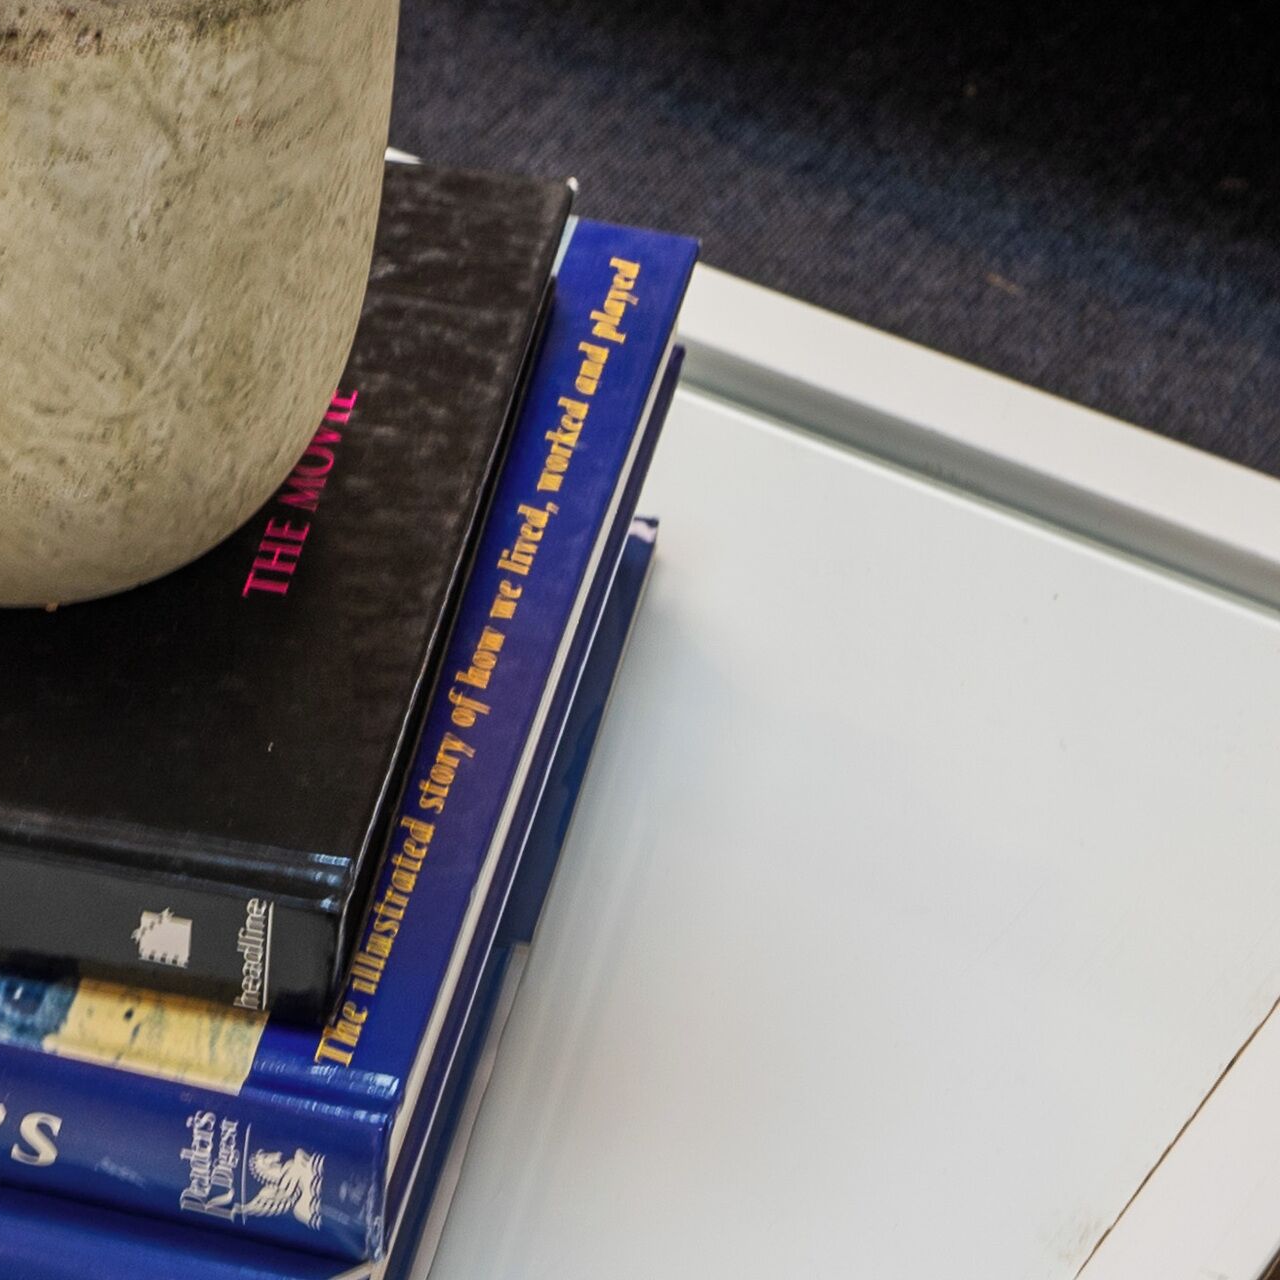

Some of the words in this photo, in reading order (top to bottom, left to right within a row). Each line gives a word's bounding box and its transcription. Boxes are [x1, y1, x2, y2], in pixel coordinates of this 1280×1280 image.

[590, 257, 640, 344] played
[575, 342, 609, 395] and
[537, 397, 589, 491] worked
[243, 521, 309, 596] THE
[498, 503, 558, 575] lived,
[490, 580, 522, 617] we
[456, 627, 505, 689] how
[449, 687, 492, 728] of
[420, 737, 475, 813] story
[353, 818, 434, 993] illustrated
[234, 897, 267, 1010] headline
[315, 1007, 367, 1066] The
